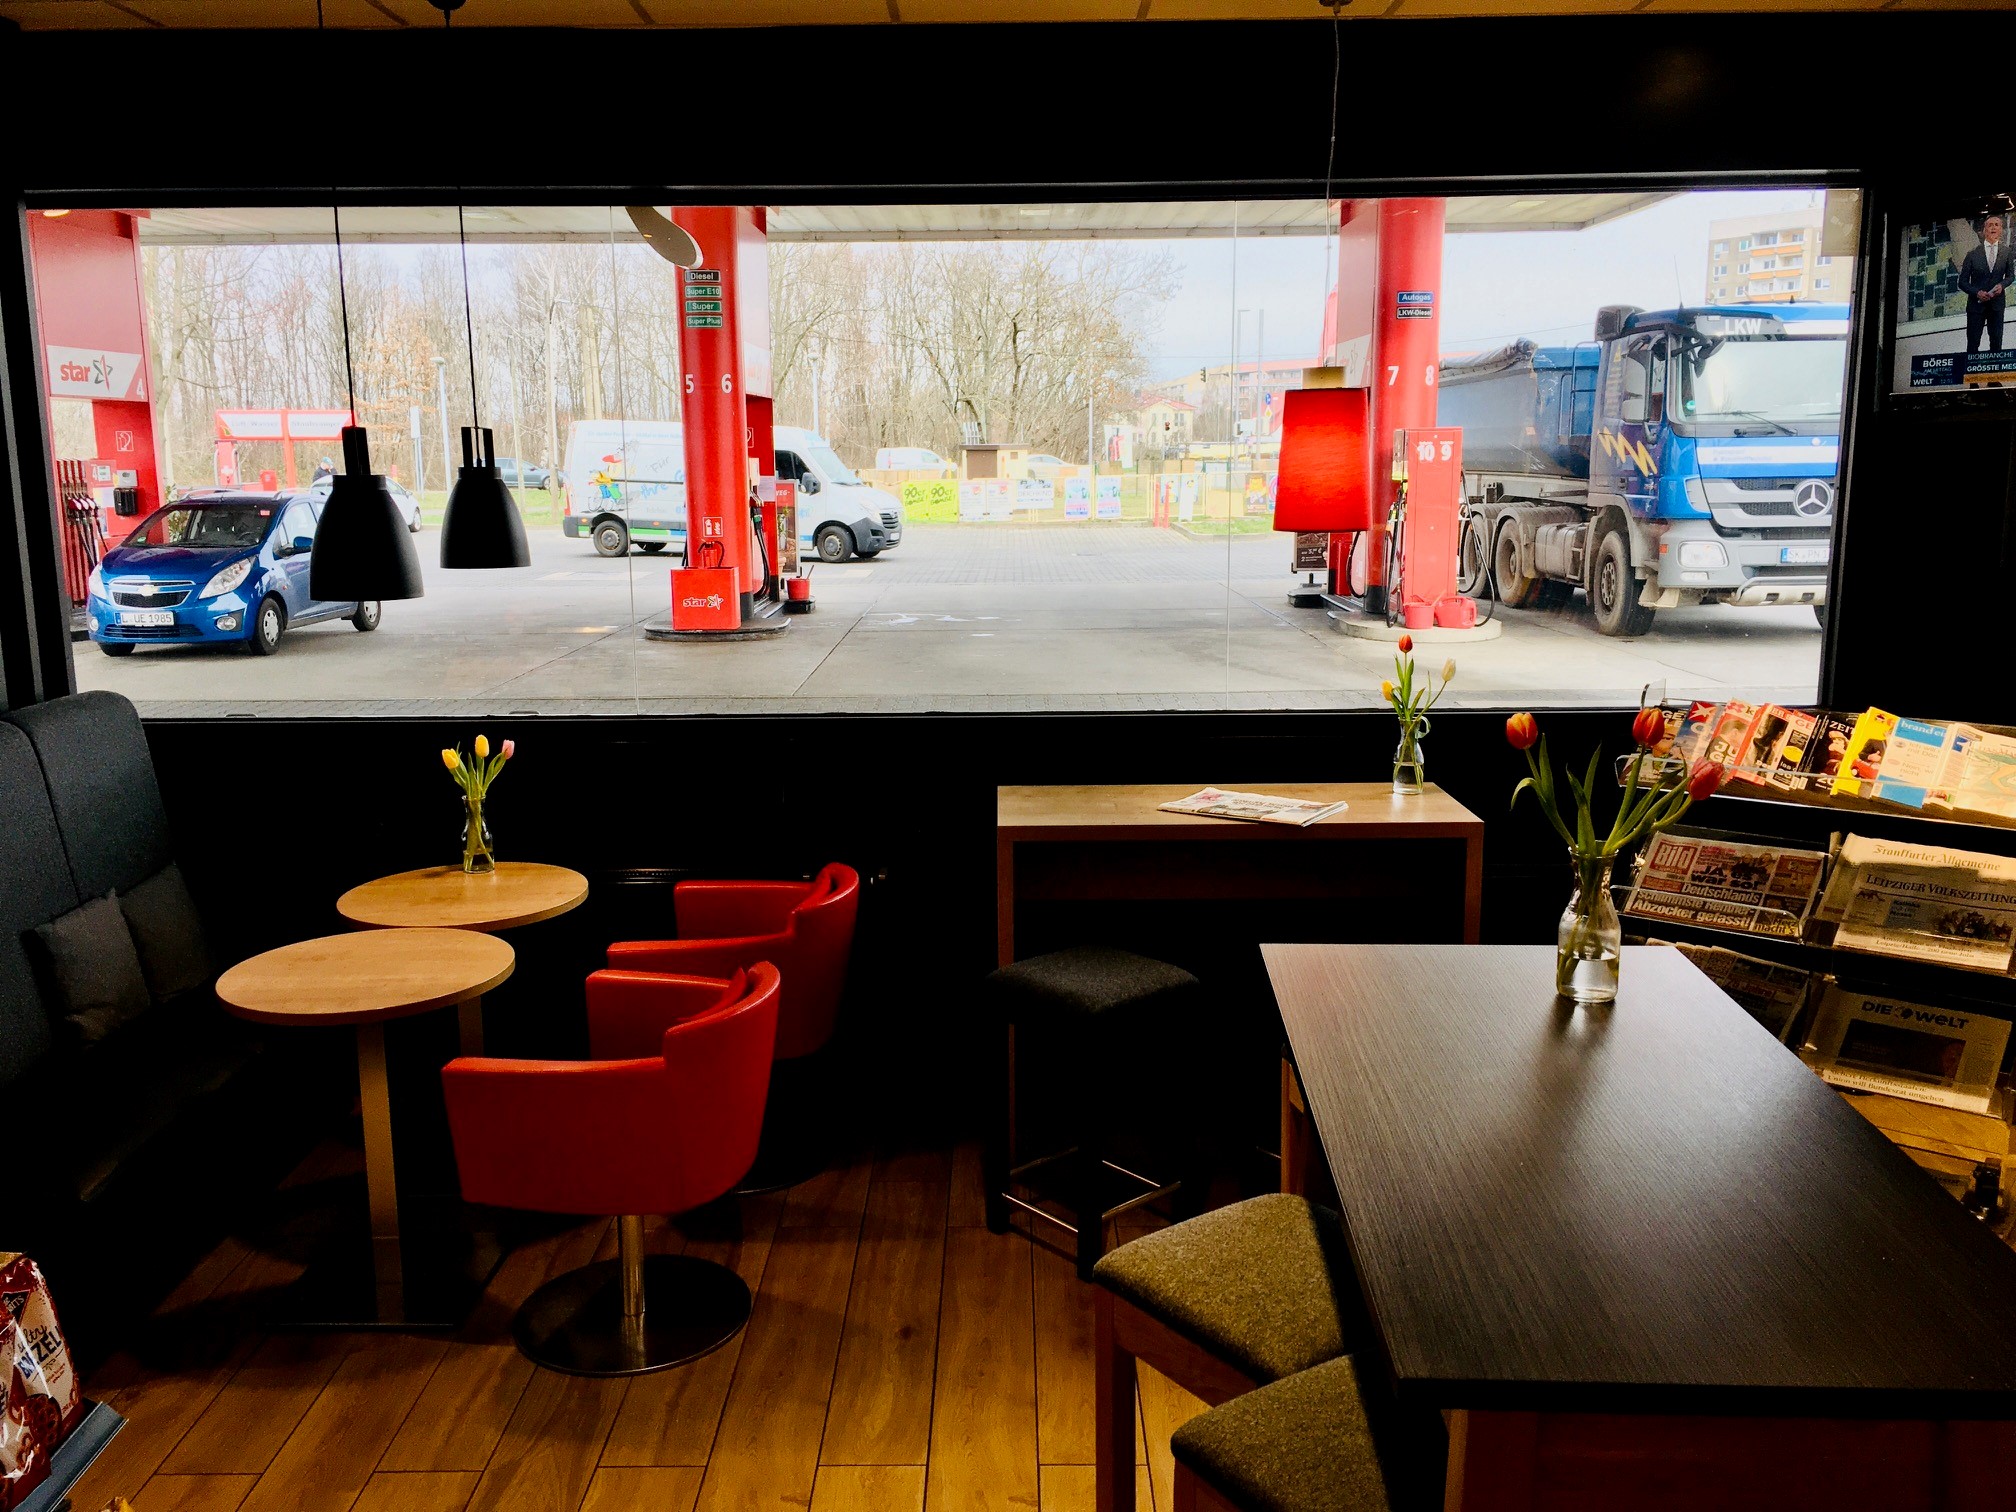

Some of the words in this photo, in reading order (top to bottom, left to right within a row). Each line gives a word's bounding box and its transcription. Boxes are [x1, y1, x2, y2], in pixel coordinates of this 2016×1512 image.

[690, 272, 714, 280] Diesel
[686, 288, 705, 296] Super
[706, 287, 720, 295] E10
[1401, 293, 1432, 302] Autogas
[691, 302, 714, 311] Super
[1725, 319, 1762, 335] LKW
[1922, 358, 1954, 368] BÖRSE
[1967, 351, 2014, 361] BIOBRANCHE
[60, 361, 91, 382] star
[1387, 365, 1399, 386] 7
[1425, 365, 1435, 386] 8
[1966, 364, 2000, 372] GRÖSSTE
[136, 378, 145, 399] 4
[685, 373, 695, 394] 5
[721, 373, 732, 394] 6
[1417, 444, 1435, 461] 10
[1440, 444, 1452, 461] 9
[682, 597, 707, 607] star
[149, 614, 172, 623] 1985
[1900, 720, 1933, 736] brand
[1681, 882, 1761, 904] Deutschlands
[1866, 873, 1926, 893] LEIPZIGER
[1928, 883, 2016, 905] VOLKSZEITUNG
[1631, 899, 1694, 919] Abzocker
[1861, 1001, 1894, 1016] DIE
[1867, 1082, 1908, 1097] Bundesrat
